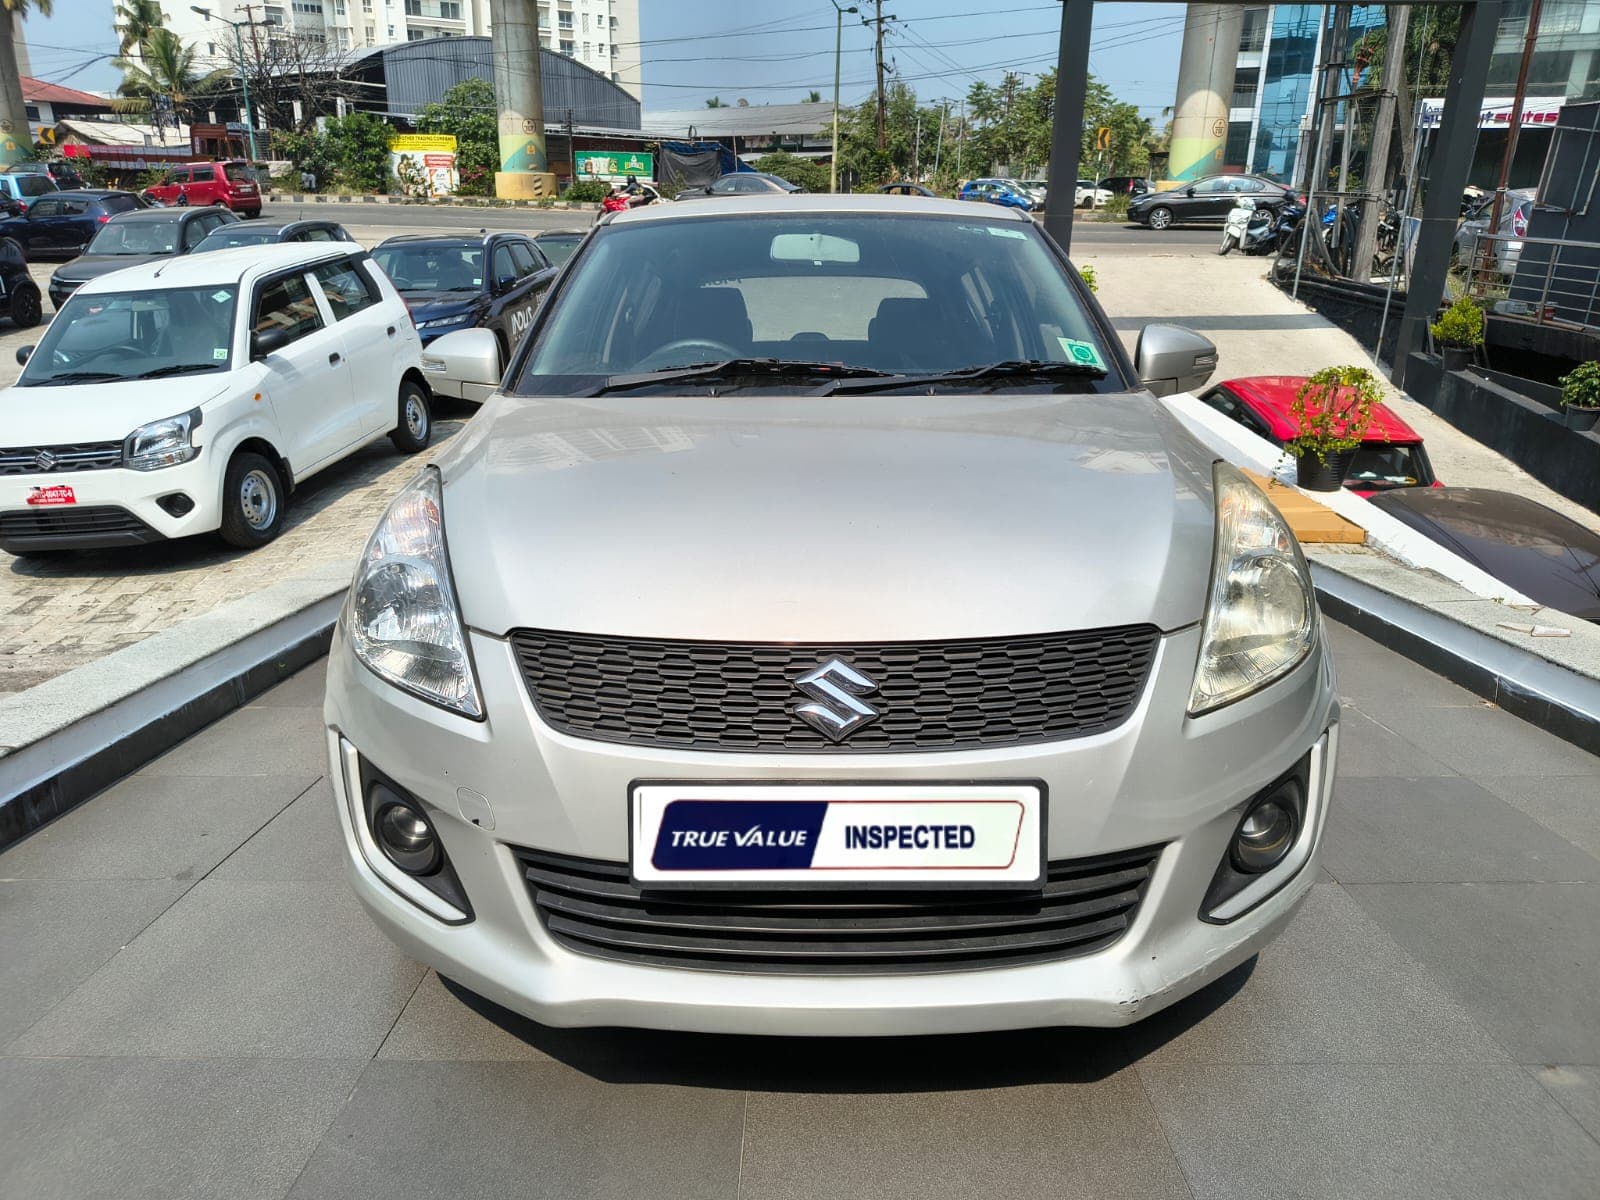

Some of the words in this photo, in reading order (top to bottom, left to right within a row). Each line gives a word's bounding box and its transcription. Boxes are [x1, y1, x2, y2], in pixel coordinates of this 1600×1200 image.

[1495, 111, 1559, 123] sites
[671, 831, 727, 847] TRUE
[734, 824, 808, 847] VALUE
[844, 825, 975, 850] INSPECTED
